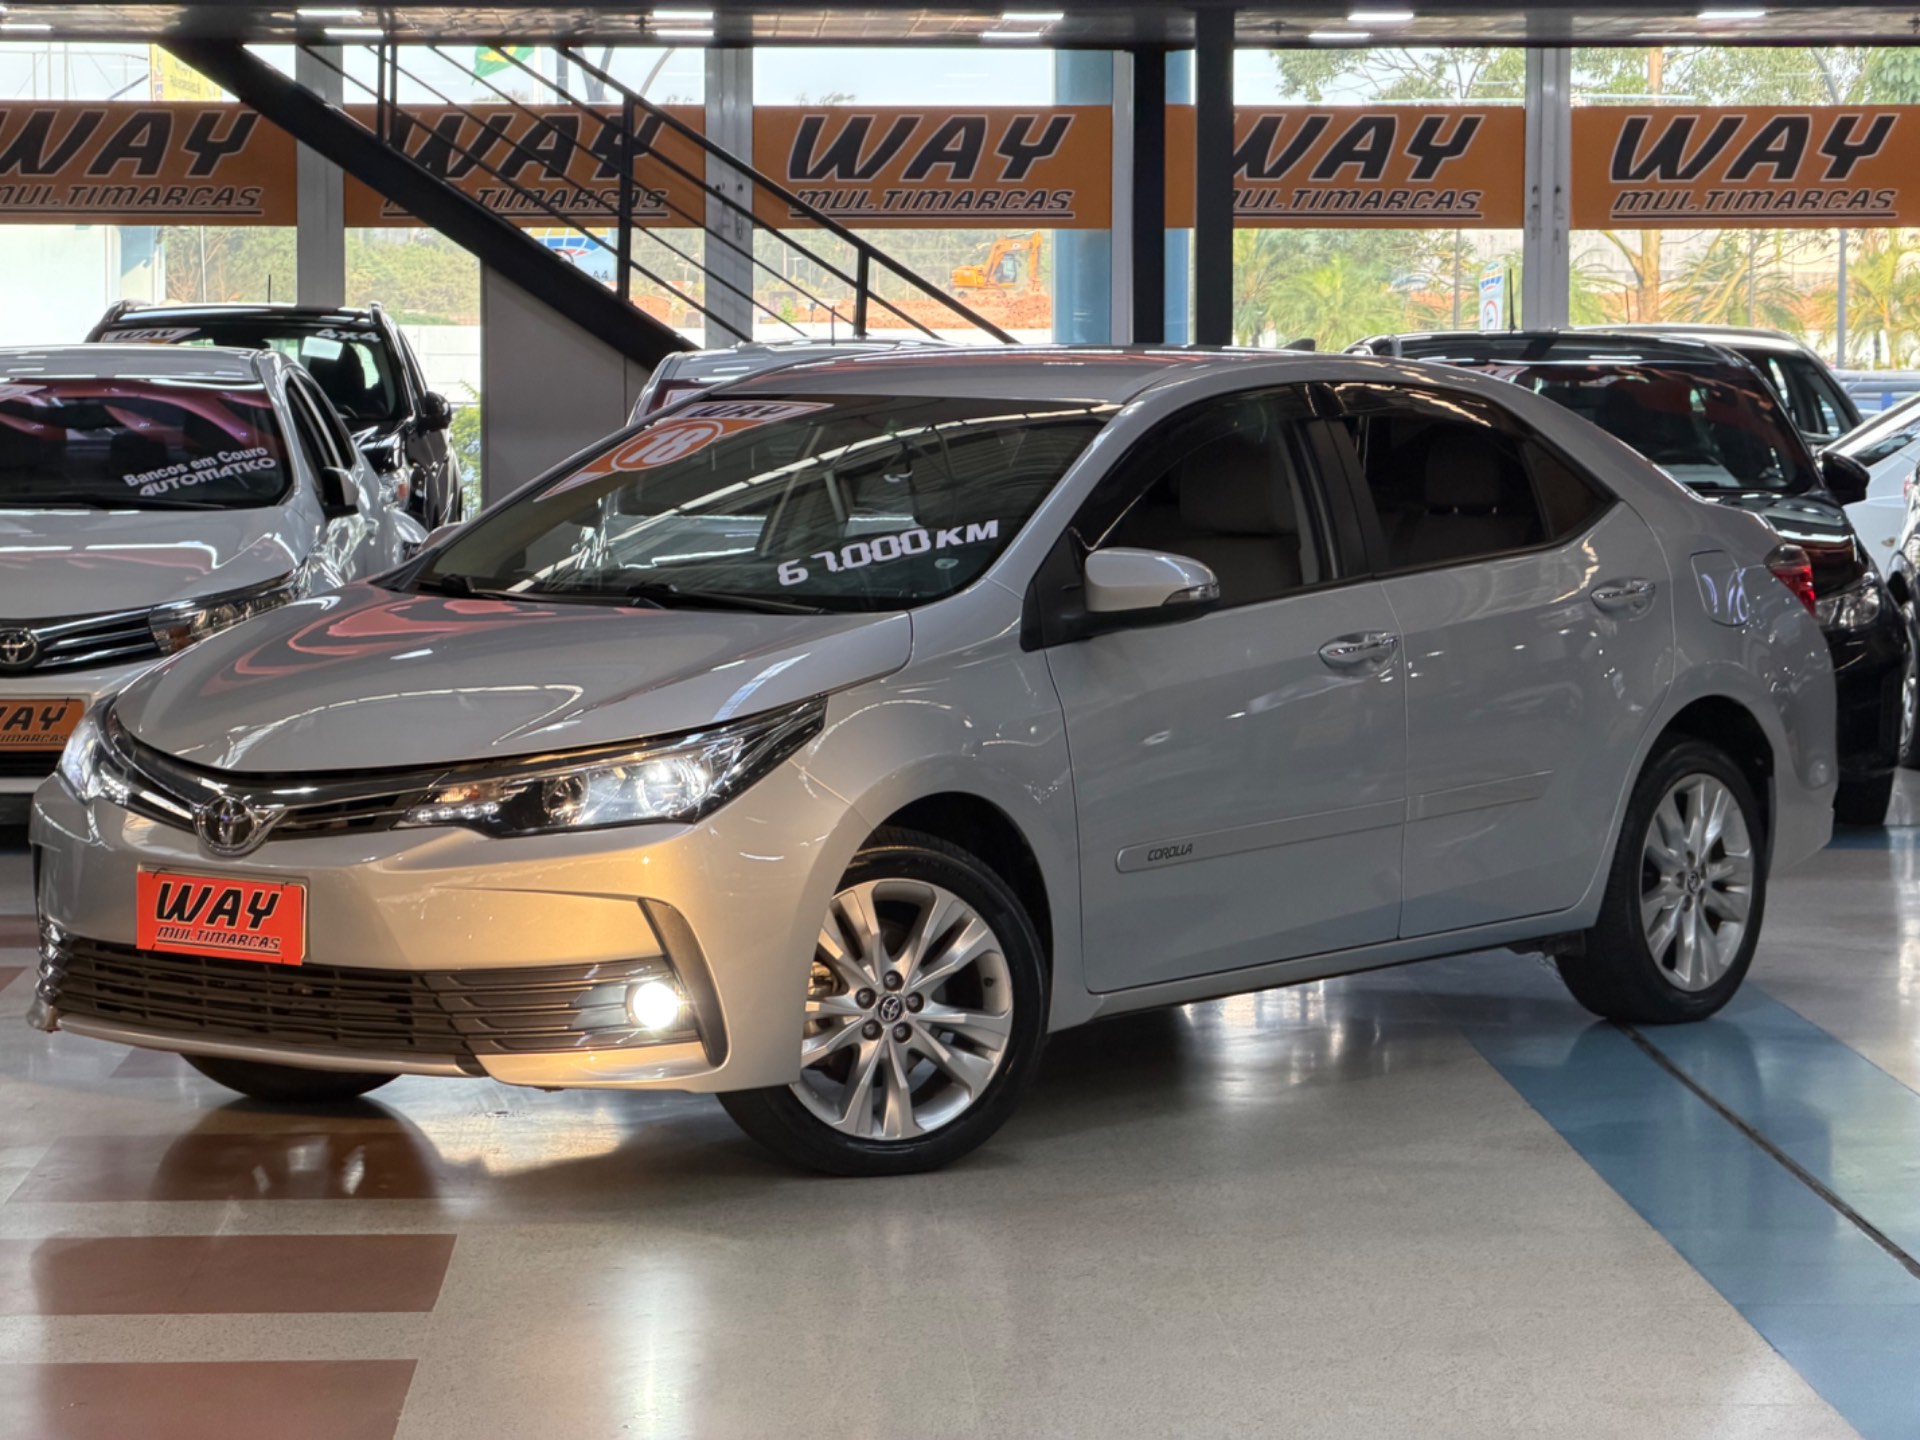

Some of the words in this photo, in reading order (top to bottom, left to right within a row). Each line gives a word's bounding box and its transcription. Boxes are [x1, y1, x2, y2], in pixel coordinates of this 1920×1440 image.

[0, 109, 261, 178] WAY
[787, 114, 1076, 182] WAY
[1609, 113, 1900, 183] WAY
[1611, 188, 1897, 211] MULTIMARCAS
[685, 404, 795, 418] WAY
[620, 427, 714, 464] 18
[122, 463, 188, 487] Bancos
[190, 456, 217, 470] em
[217, 447, 268, 463] Couro
[0, 705, 68, 731] AY
[1147, 843, 1193, 861] COROLLA
[155, 881, 281, 930] WAY
[156, 926, 281, 950] MULTIMARCAS
